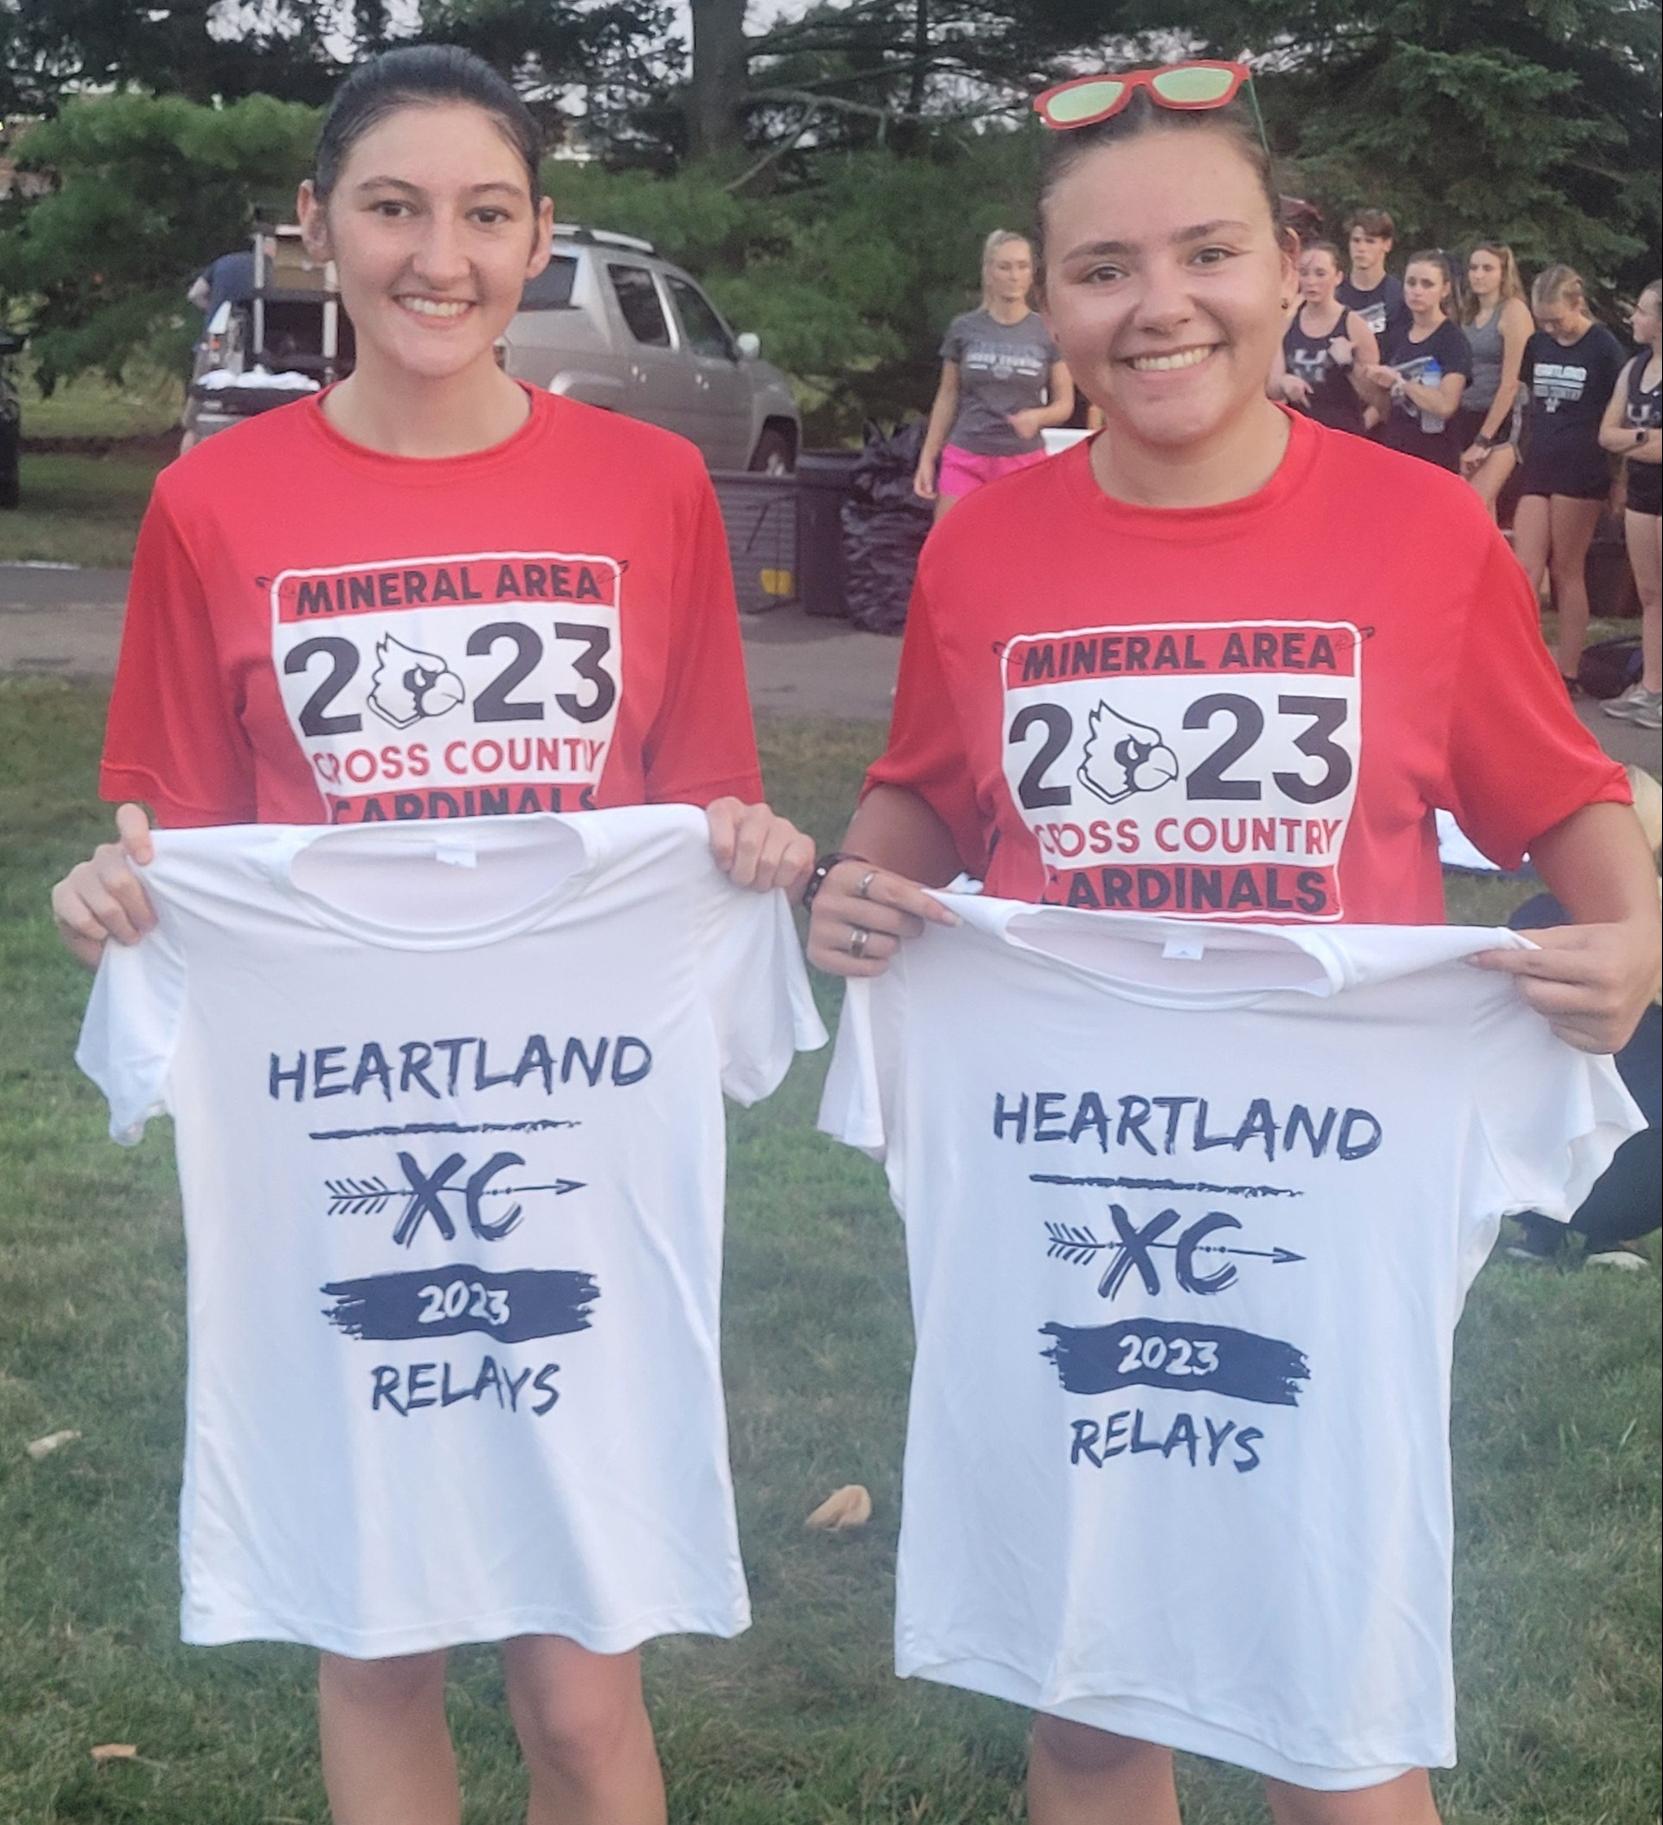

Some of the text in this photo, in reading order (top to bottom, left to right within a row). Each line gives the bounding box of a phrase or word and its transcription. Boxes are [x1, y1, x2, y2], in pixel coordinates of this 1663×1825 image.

[297, 561, 600, 615] MINERAL AREA
[1022, 632, 1336, 681] MINERAL AREA
[445, 737, 605, 775] COUNTY
[1154, 817, 1343, 855] COUNTRY
[1041, 866, 1327, 913] ARDINALS
[269, 1034, 653, 1102] HEARTLAND
[993, 1091, 1383, 1162] HEARTLAND
[392, 1151, 526, 1249] XC
[1098, 1203, 1243, 1301] XC
[416, 1280, 511, 1325] 2023
[1117, 1334, 1220, 1376] 2023
[370, 1355, 562, 1417] RELAYS
[1070, 1408, 1264, 1473] RELAYS
